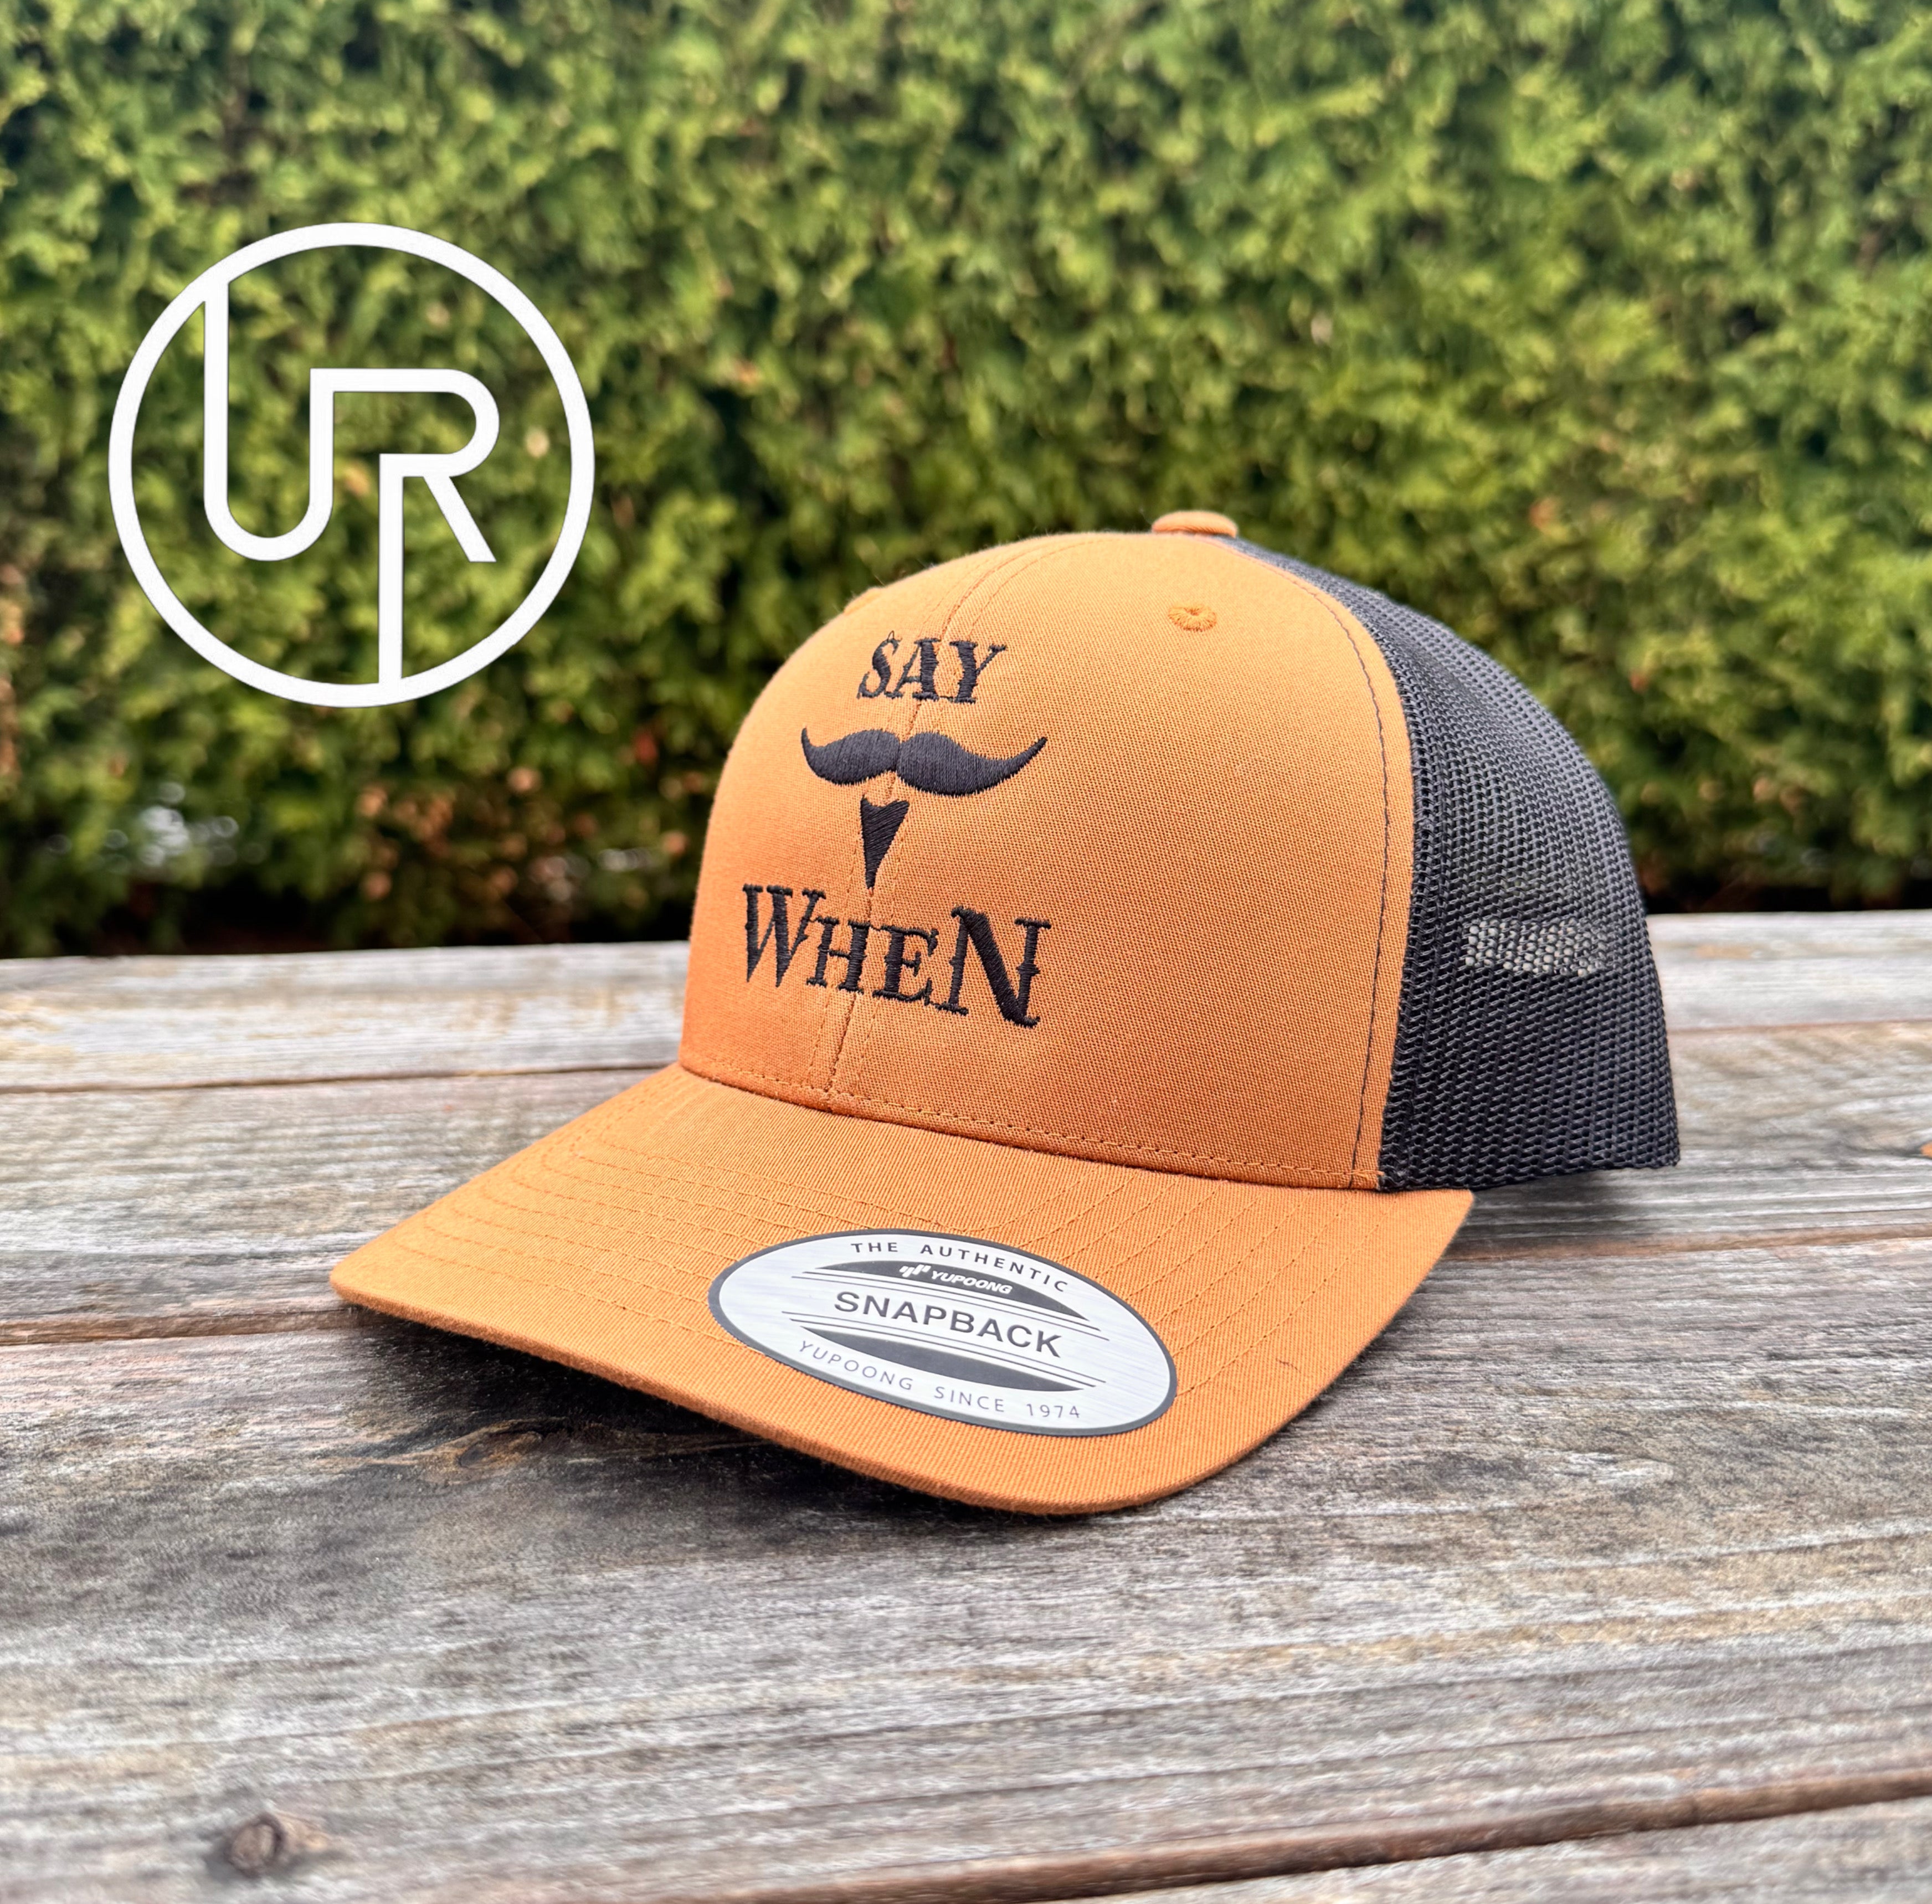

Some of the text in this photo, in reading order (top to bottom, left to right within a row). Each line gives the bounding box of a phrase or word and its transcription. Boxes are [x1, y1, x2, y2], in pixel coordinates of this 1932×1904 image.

[856, 631, 1007, 703] SAY
[742, 883, 1052, 1028] WHEN
[851, 1242, 1068, 1293] THE AUTHENTIC
[931, 1270, 1014, 1295] YUPOONG
[834, 1290, 1061, 1358] SNAPBACK
[798, 1340, 1082, 1419] YUPOONG SINCE 1974
